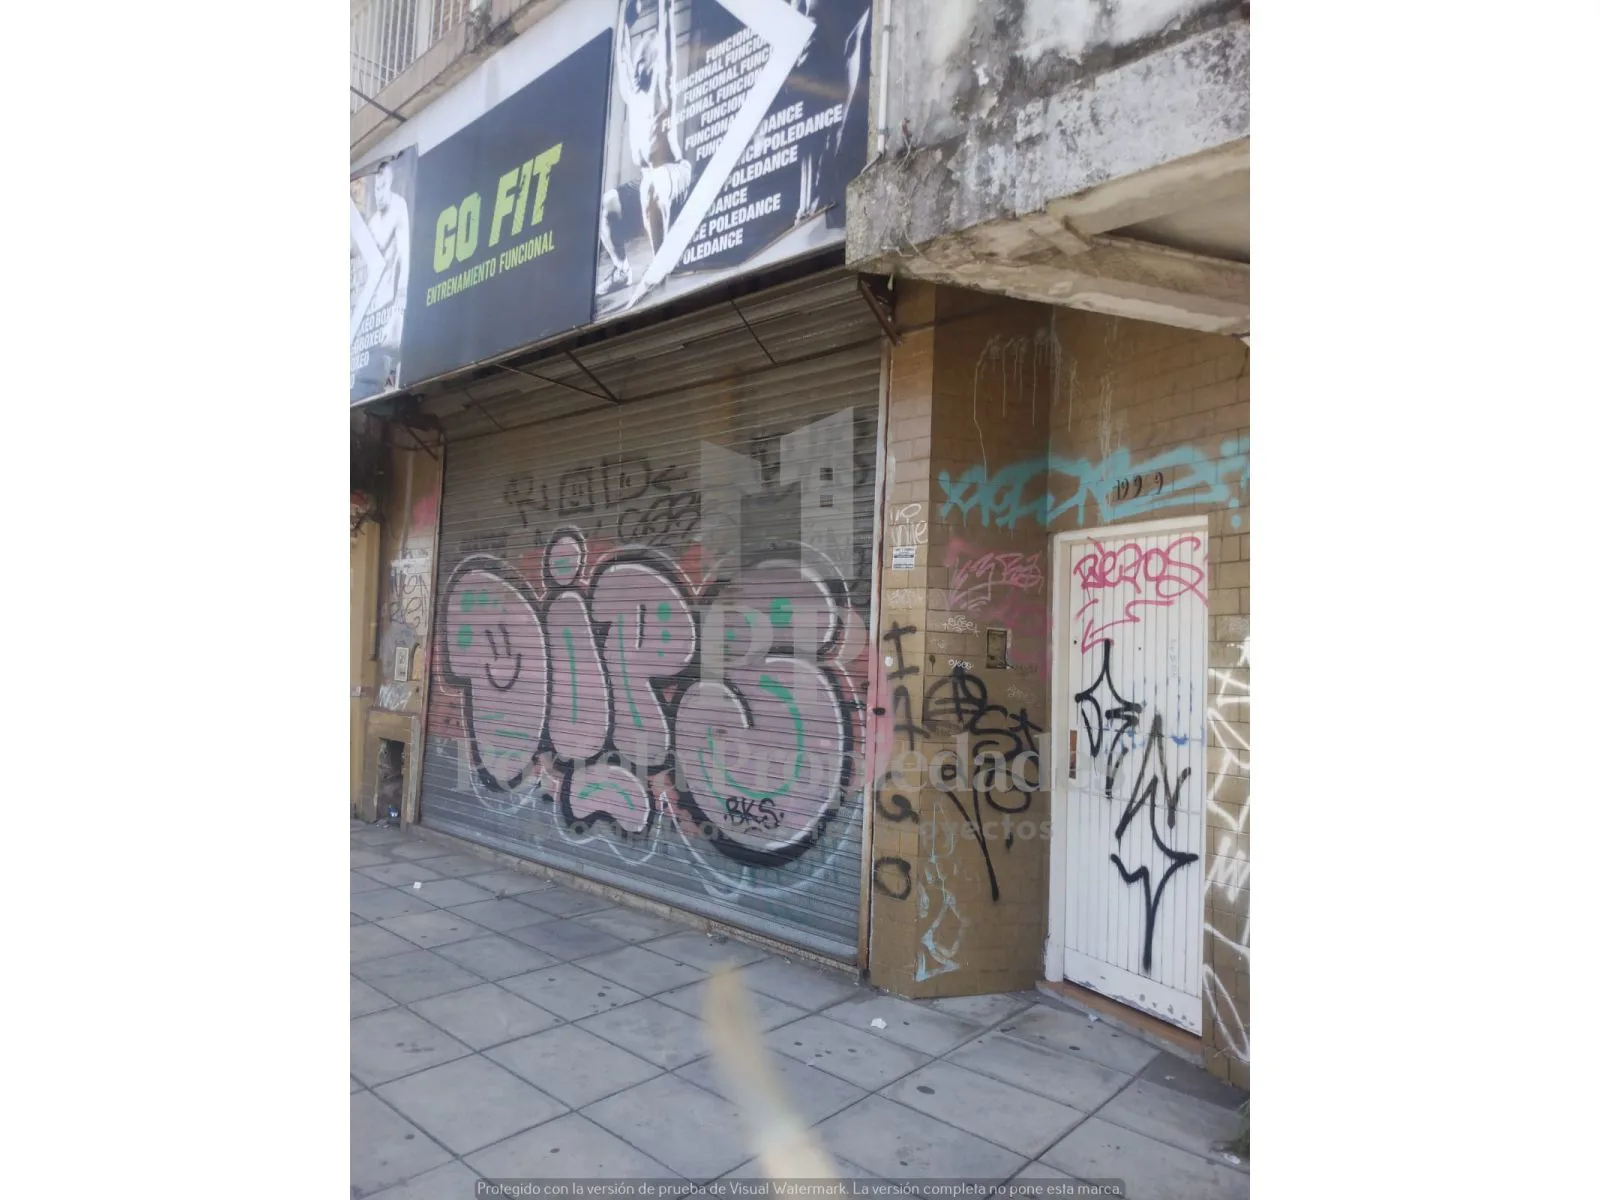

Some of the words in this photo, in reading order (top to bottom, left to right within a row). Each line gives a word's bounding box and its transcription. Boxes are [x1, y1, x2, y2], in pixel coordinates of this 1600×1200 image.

[763, 103, 843, 155] POLEDANCE
[434, 192, 481, 273] GO
[488, 142, 563, 247] FIT
[708, 193, 782, 237] POLEDANCE
[426, 257, 497, 307] ENTRENAMIENTO
[499, 230, 555, 274] FUNCIONAL
